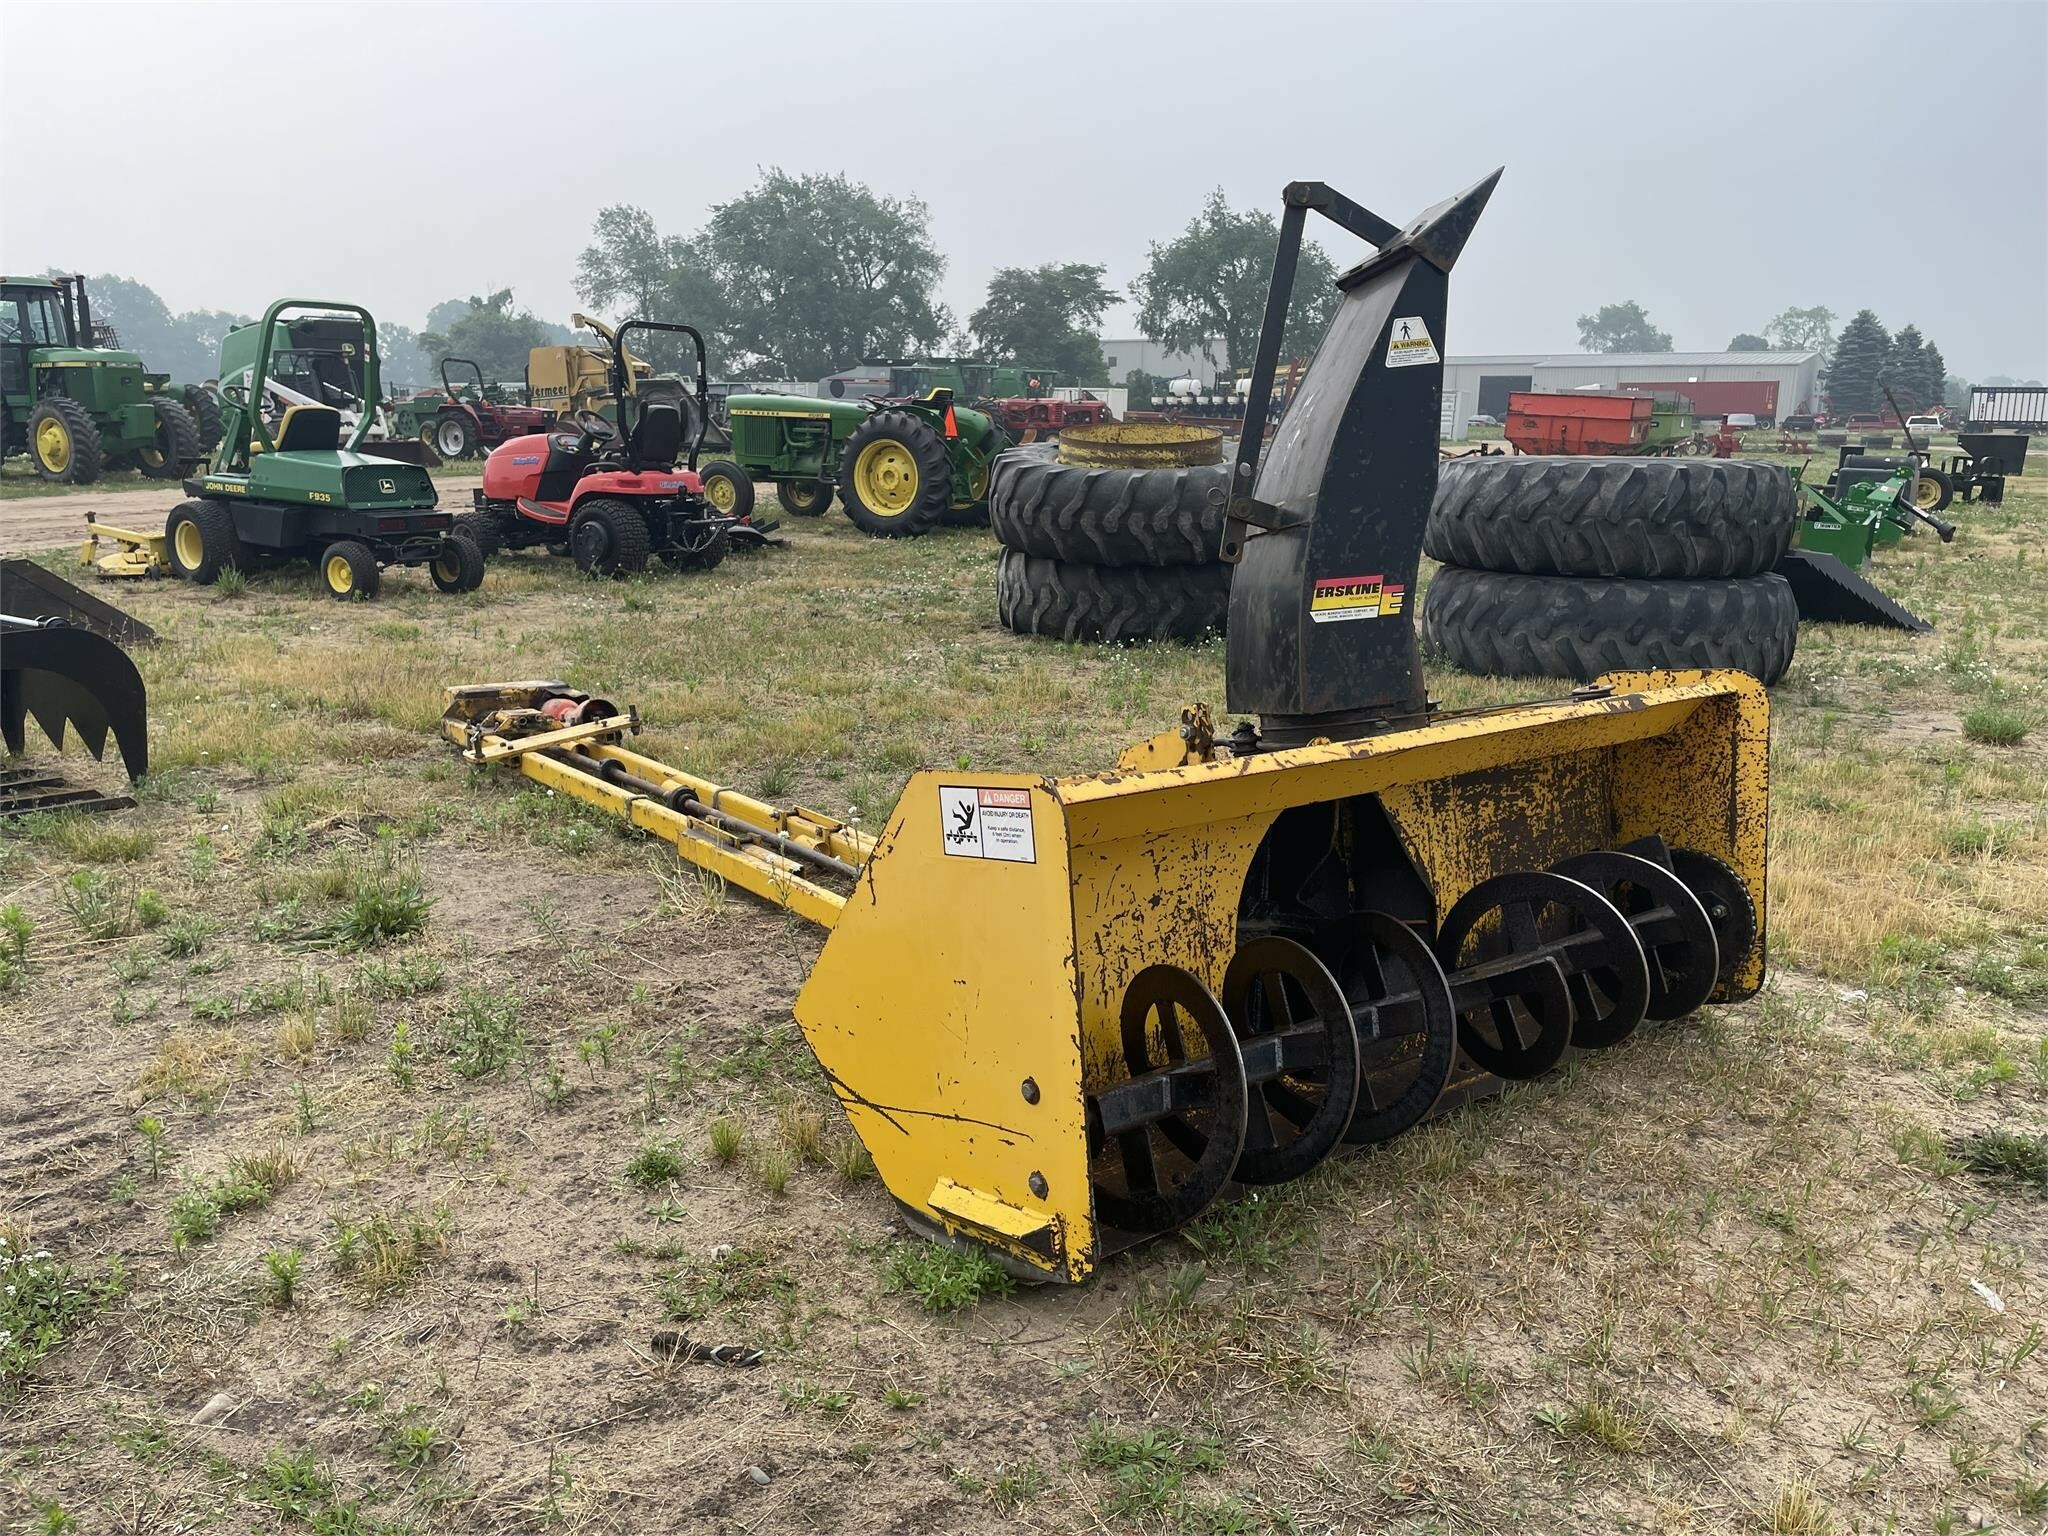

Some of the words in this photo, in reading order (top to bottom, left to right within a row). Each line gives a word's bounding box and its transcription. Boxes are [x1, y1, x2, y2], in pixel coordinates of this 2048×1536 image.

[1400, 340, 1429, 348] WARNING
[205, 482, 223, 491] JOHN
[225, 484, 246, 494] DEERE
[309, 492, 331, 502] F935
[1315, 583, 1380, 598] ERSKINE
[993, 793, 1026, 804] DANGER
